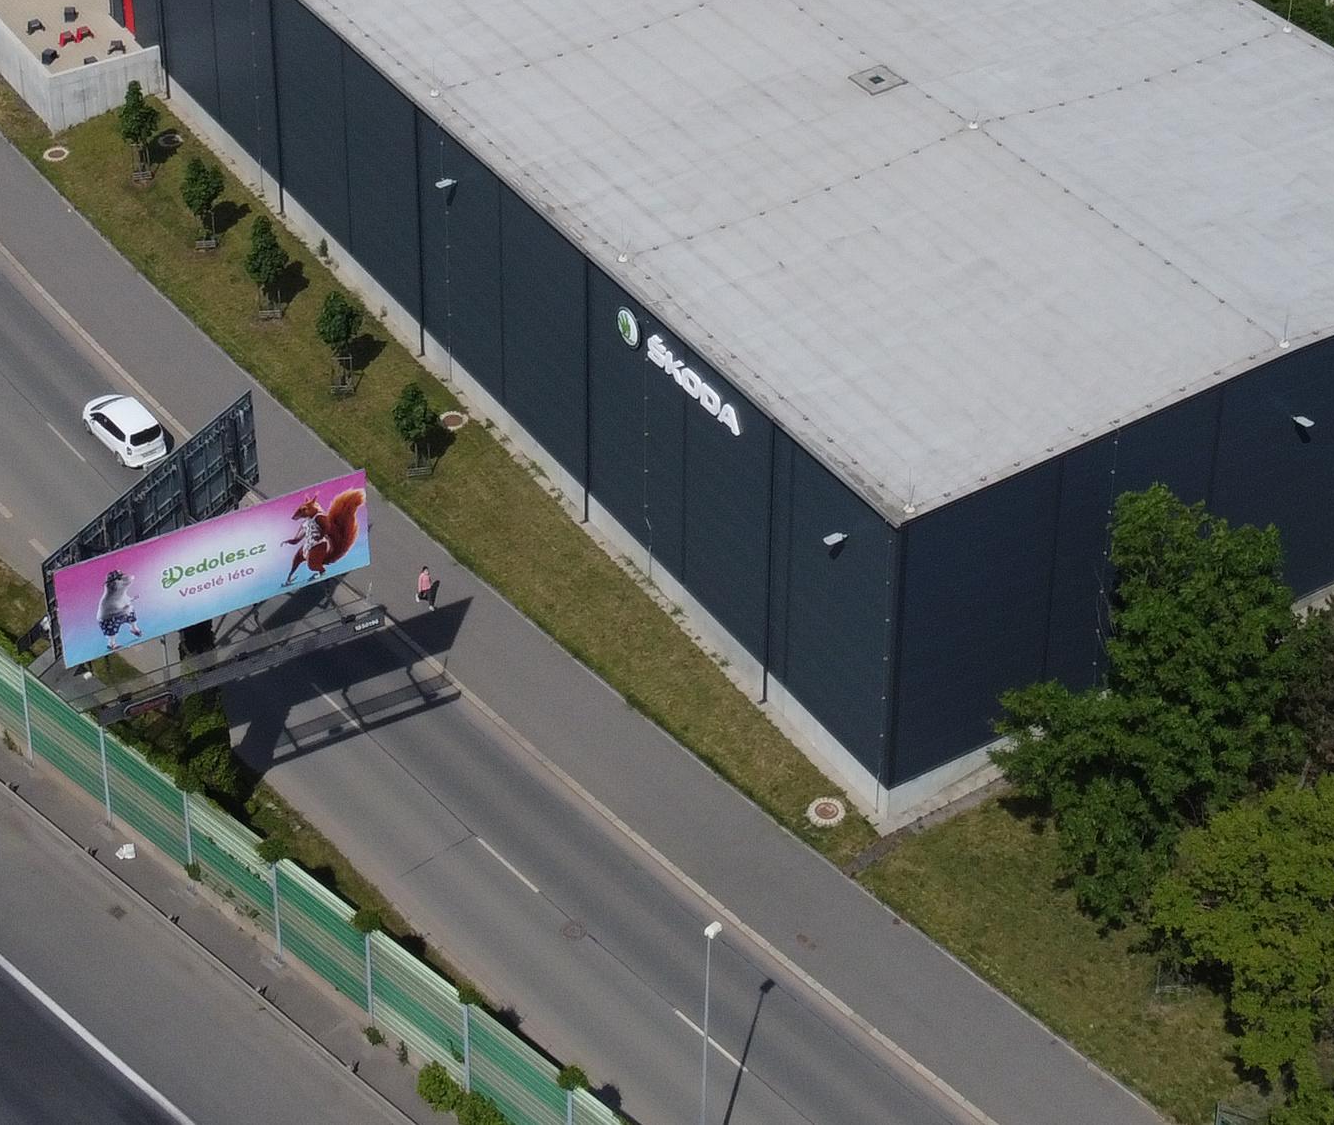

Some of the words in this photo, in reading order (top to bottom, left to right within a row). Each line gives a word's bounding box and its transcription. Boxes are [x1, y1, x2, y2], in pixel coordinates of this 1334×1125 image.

[647, 334, 741, 436] ŠKODA
[161, 543, 267, 589] Dedoles.cz
[179, 575, 224, 597] Veselé
[228, 567, 255, 581] léto
